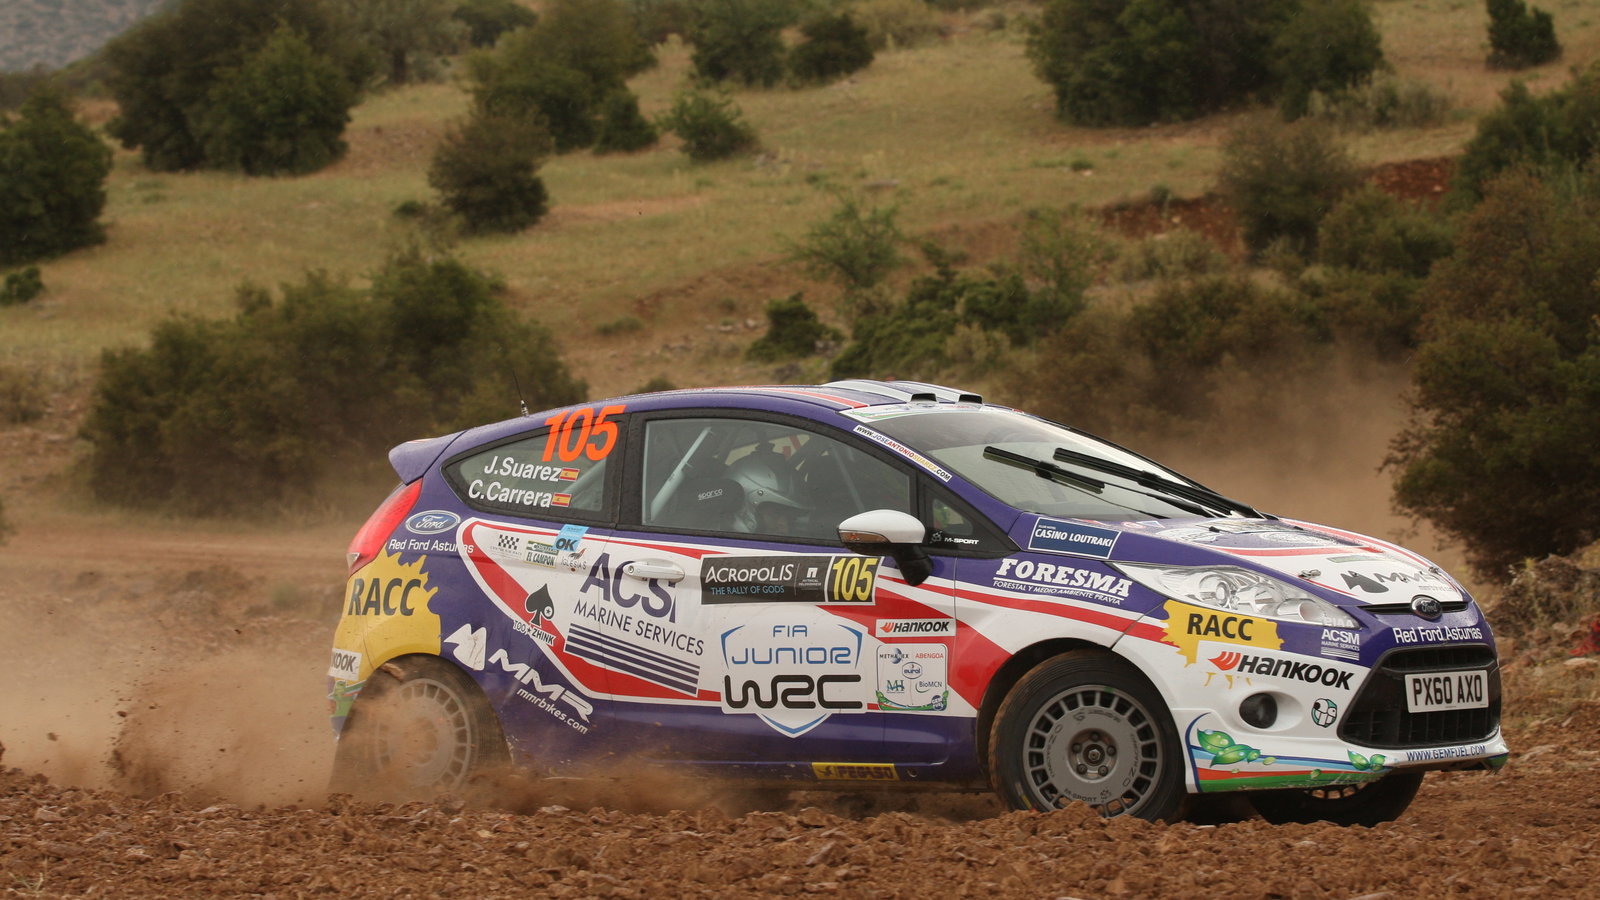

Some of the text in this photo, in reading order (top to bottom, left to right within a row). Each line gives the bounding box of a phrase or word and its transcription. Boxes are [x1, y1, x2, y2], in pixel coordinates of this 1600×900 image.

[542, 404, 627, 463] 105
[856, 426, 951, 481] WWW.JOSEANTONIOSUAREZ.COM
[484, 455, 562, 482] J.Suarez
[468, 479, 552, 508] C.Carrera
[415, 515, 446, 530] Ford
[388, 539, 475, 554] Red Ford Asturas
[555, 538, 577, 551] OK
[1035, 528, 1114, 548] CASINO LOUTRAKI
[704, 563, 795, 583] ACROPOLIS
[832, 557, 879, 602] 105
[995, 558, 1133, 598] FORESMA
[348, 577, 422, 617] RACC
[710, 584, 785, 596] THE RALLY OF GODS
[992, 580, 1027, 591] FORESTAL
[1058, 588, 1093, 599] AMBIENTE
[1094, 593, 1121, 606] PRAVIA
[532, 627, 556, 645] ZHINK
[573, 599, 705, 656] MARINE SERVICES
[772, 624, 808, 638] FIA
[1187, 613, 1254, 641] RACC
[1321, 629, 1360, 646] ACSM
[1393, 626, 1483, 644] Red Ford Asturias
[731, 647, 852, 665] JUNIOR
[488, 648, 594, 723] MMR
[724, 674, 863, 709] WRC
[1412, 676, 1453, 706] PX60
[516, 688, 589, 735] mmrbikes.com
[1406, 744, 1487, 761] WWW.GEMFUEL.COM
